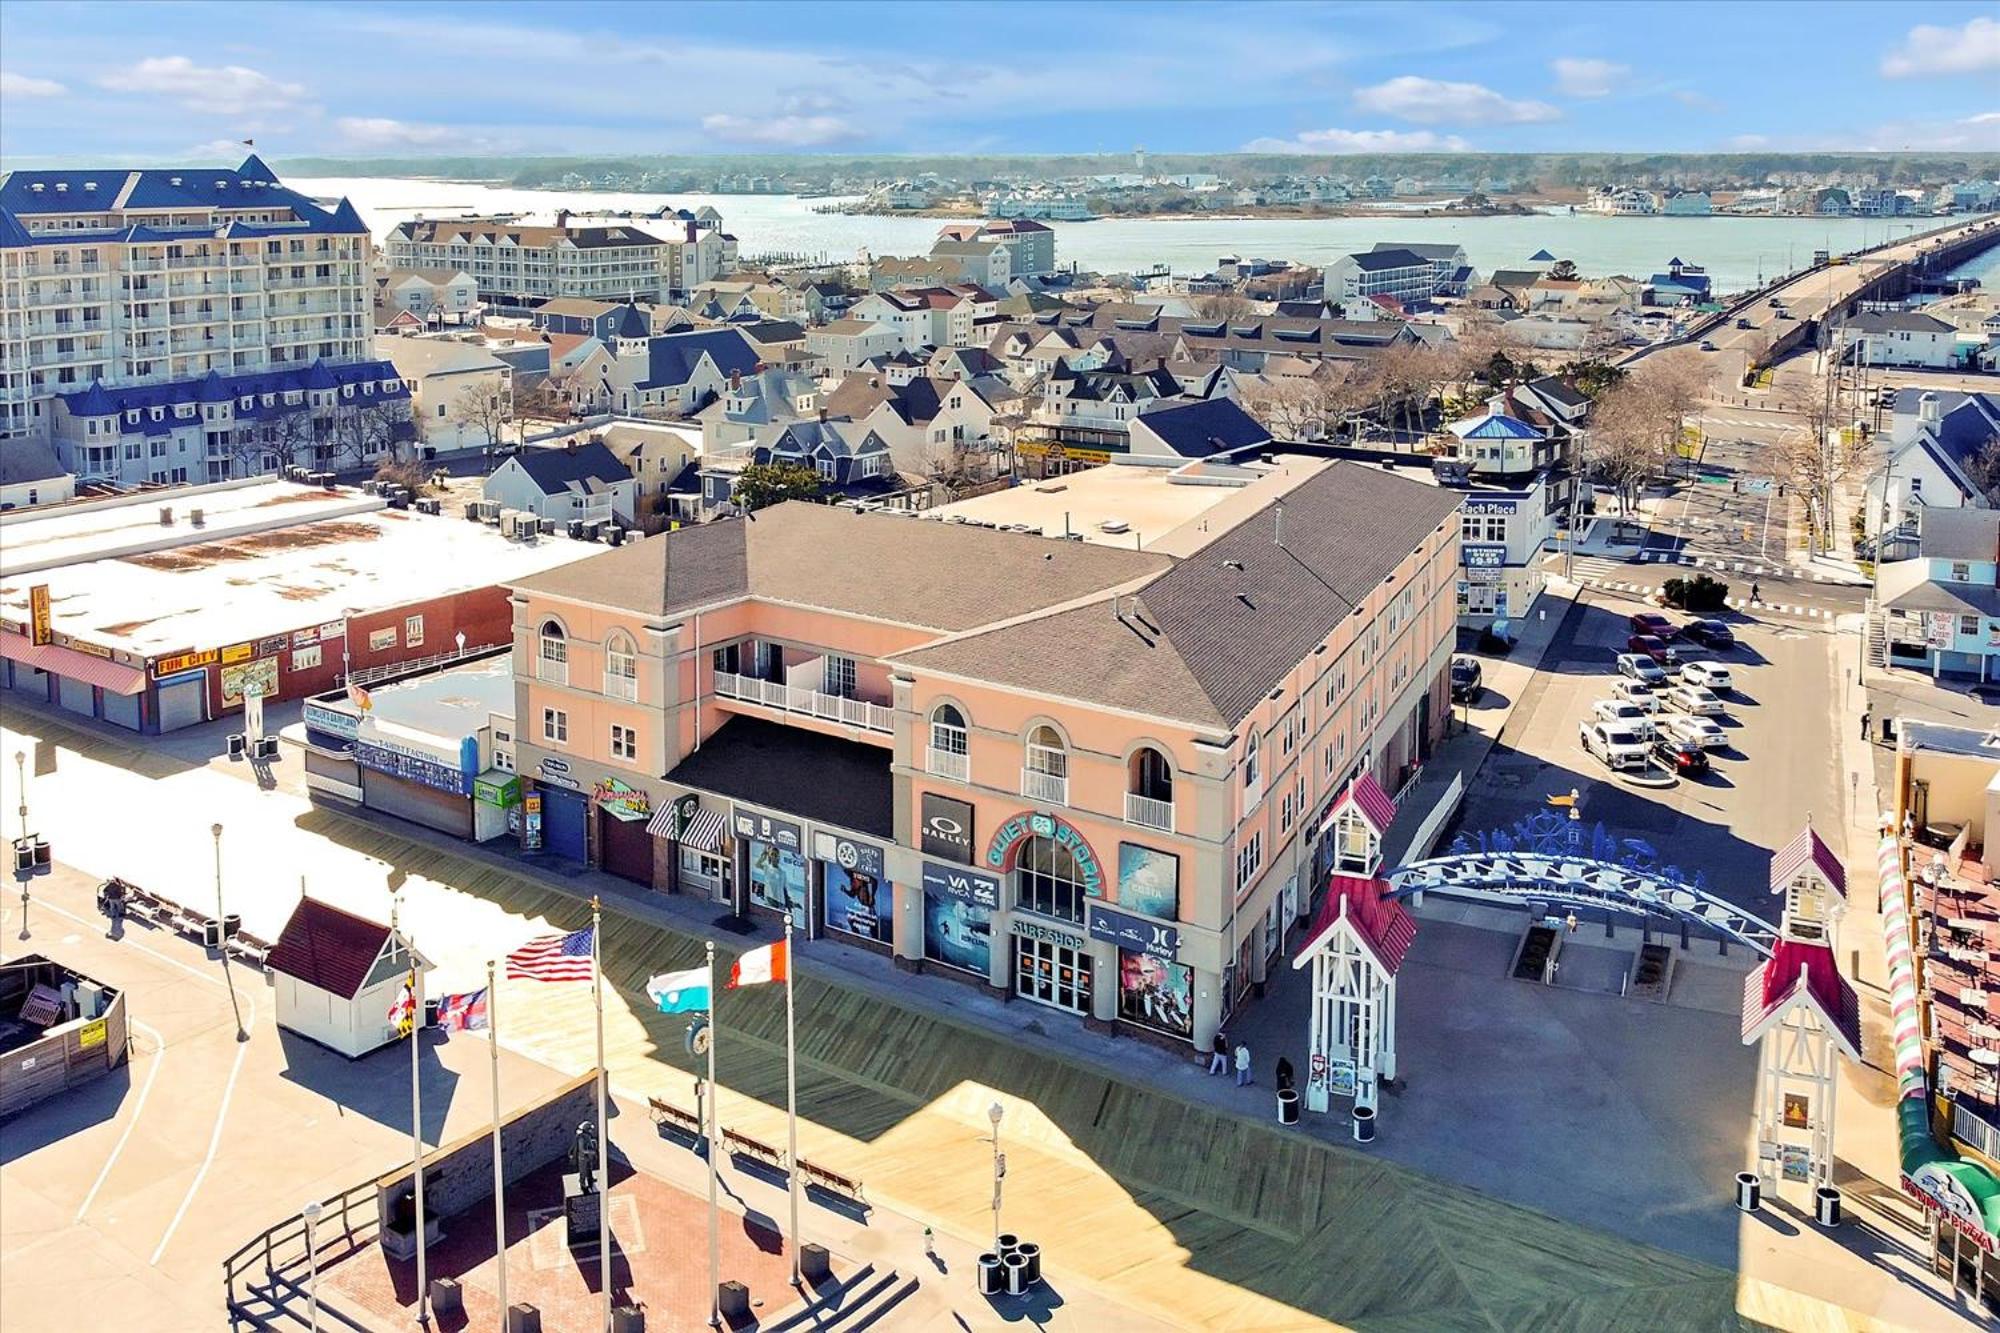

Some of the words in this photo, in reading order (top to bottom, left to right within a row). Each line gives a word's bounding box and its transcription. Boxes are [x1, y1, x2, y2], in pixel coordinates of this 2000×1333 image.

[1487, 503, 1516, 514] Place
[159, 657, 183, 673] FUN
[188, 649, 217, 666] CITY
[922, 827, 970, 847] OAKLEY
[987, 815, 1029, 867] QUIET
[1055, 824, 1103, 897] STORM
[947, 886, 970, 898] RVCA
[1013, 920, 1046, 939] SURF
[1047, 930, 1085, 950] SHOP
[1146, 942, 1174, 958] Hurley
